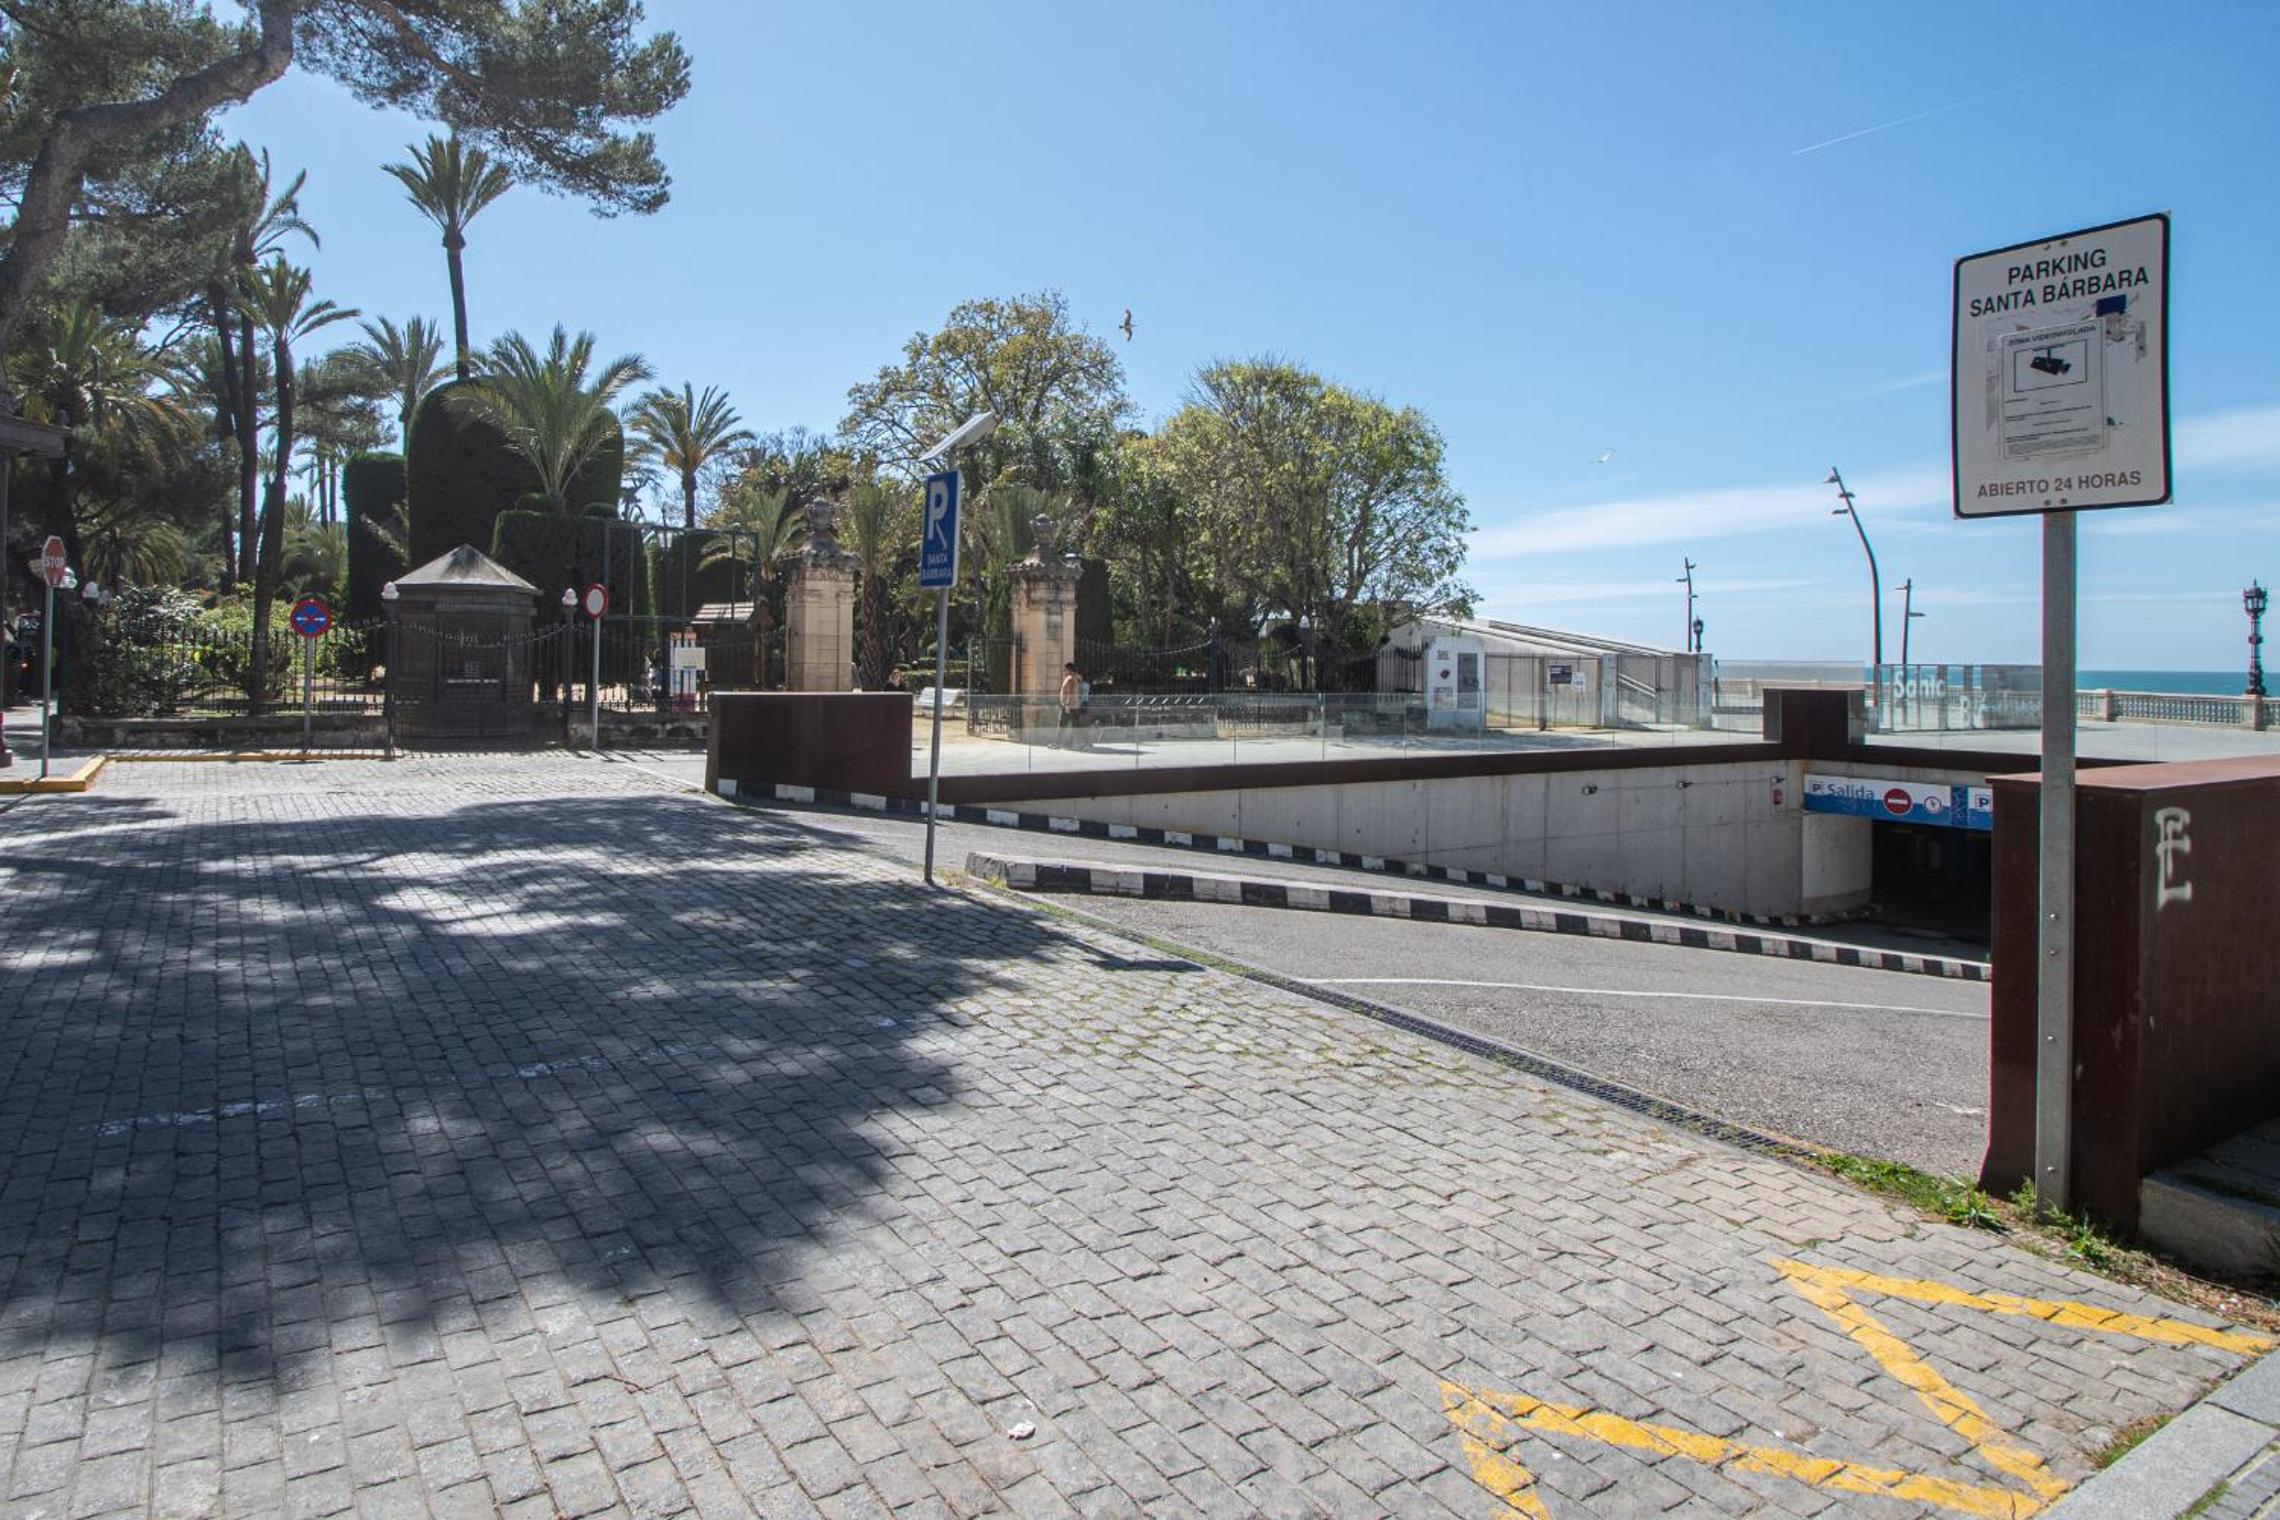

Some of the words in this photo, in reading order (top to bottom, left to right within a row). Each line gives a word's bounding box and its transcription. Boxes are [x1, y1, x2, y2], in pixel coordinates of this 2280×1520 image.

[2008, 248, 2107, 285] PARKING
[1970, 289, 2037, 318] SANTA
[2042, 266, 2149, 305] BÁRBARA
[1977, 480, 2050, 498] ABIERTO
[2054, 477, 2073, 493] 24
[2077, 470, 2142, 490] HORAS
[45, 555, 65, 568] STOP
[1828, 783, 1875, 799] Salida
